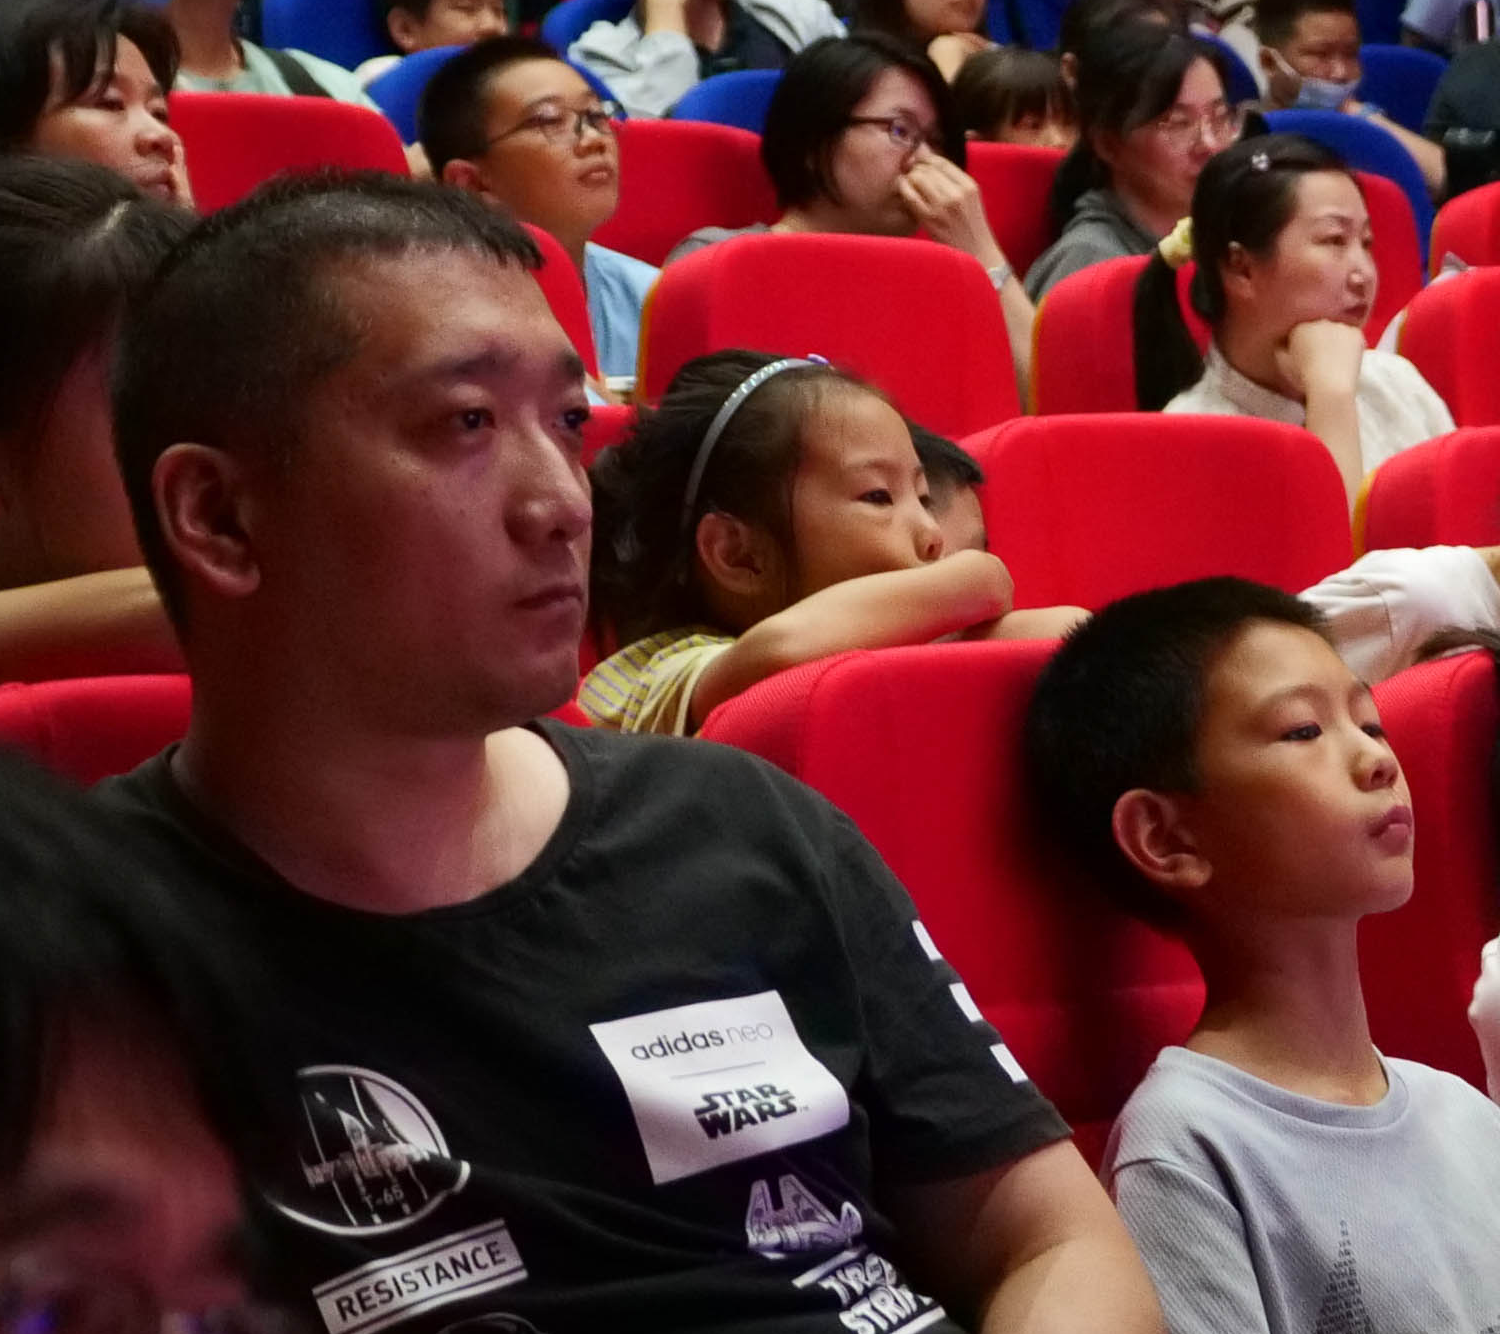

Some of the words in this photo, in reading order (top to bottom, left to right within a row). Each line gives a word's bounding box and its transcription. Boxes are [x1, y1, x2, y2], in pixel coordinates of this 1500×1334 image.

[631, 1029, 725, 1060] adidas
[727, 1023, 773, 1045] neo
[695, 1084, 790, 1115] STAR
[696, 1096, 797, 1140] WARS
[336, 1241, 506, 1322] RESISTANCE
